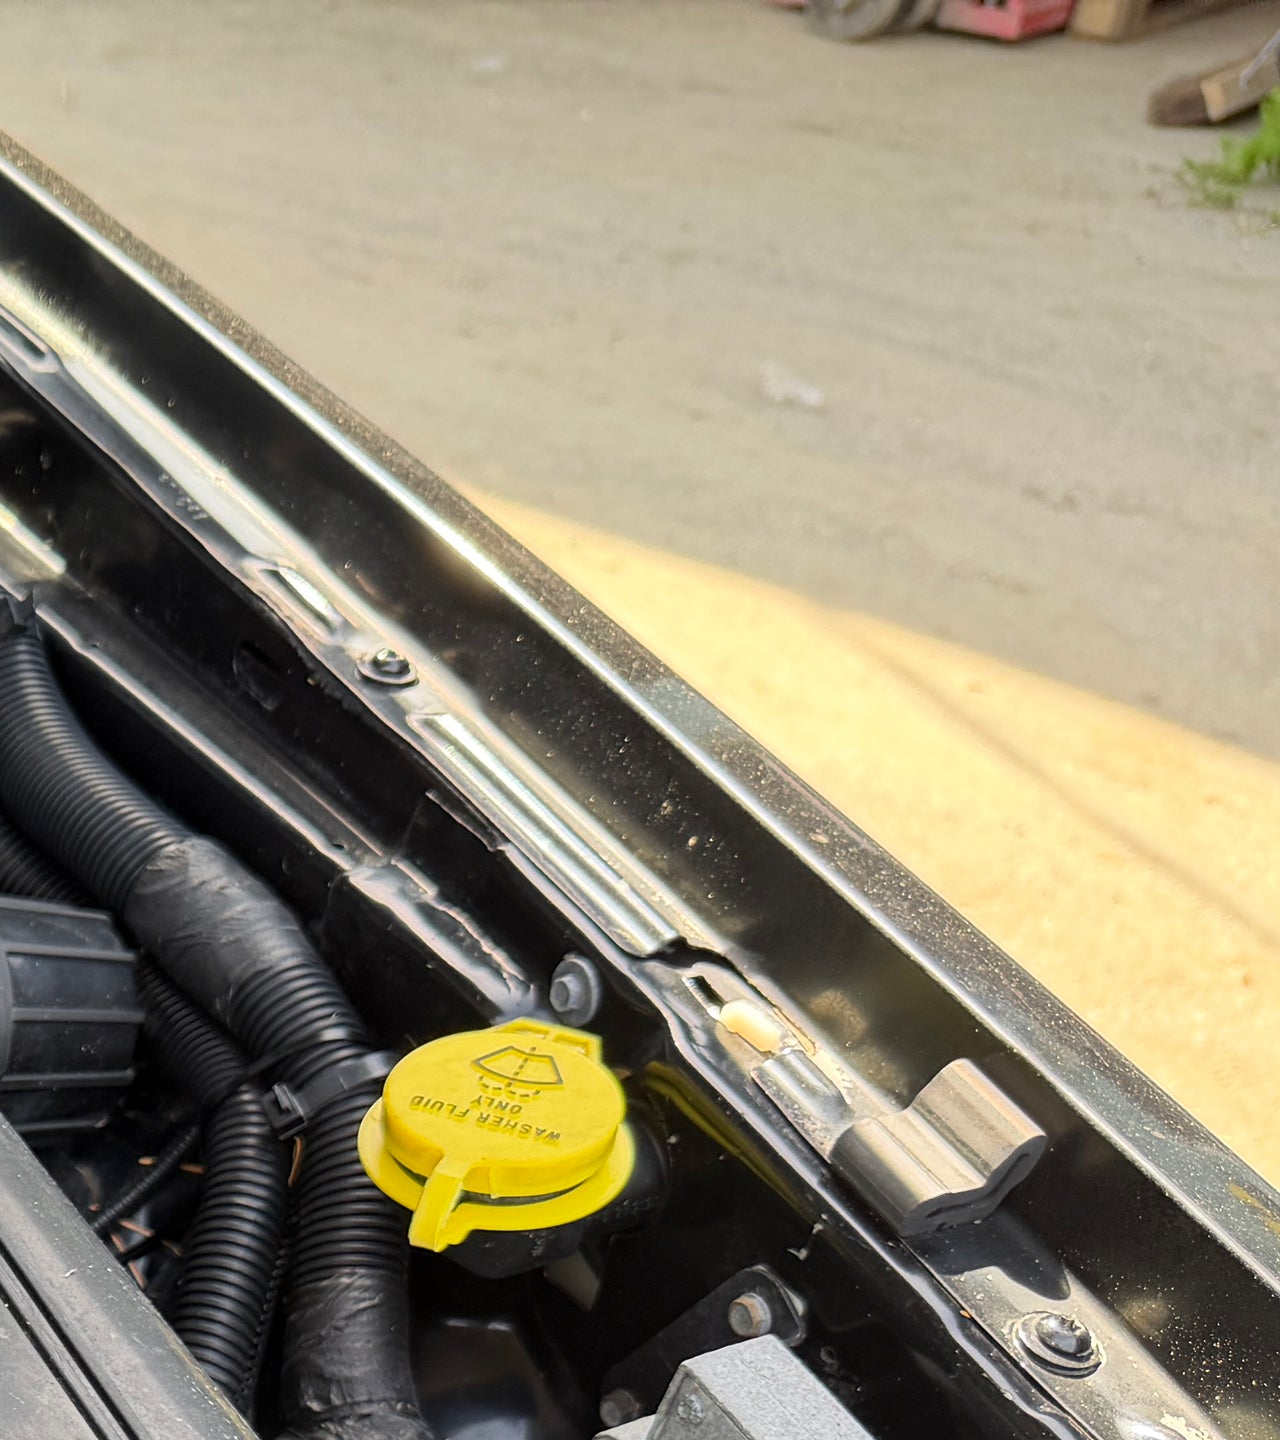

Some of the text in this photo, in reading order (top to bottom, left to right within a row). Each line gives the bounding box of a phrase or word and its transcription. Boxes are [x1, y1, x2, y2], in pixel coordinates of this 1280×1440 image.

[410, 1095, 561, 1142] WASHER FLUID
[470, 1094, 523, 1115] ONLY
